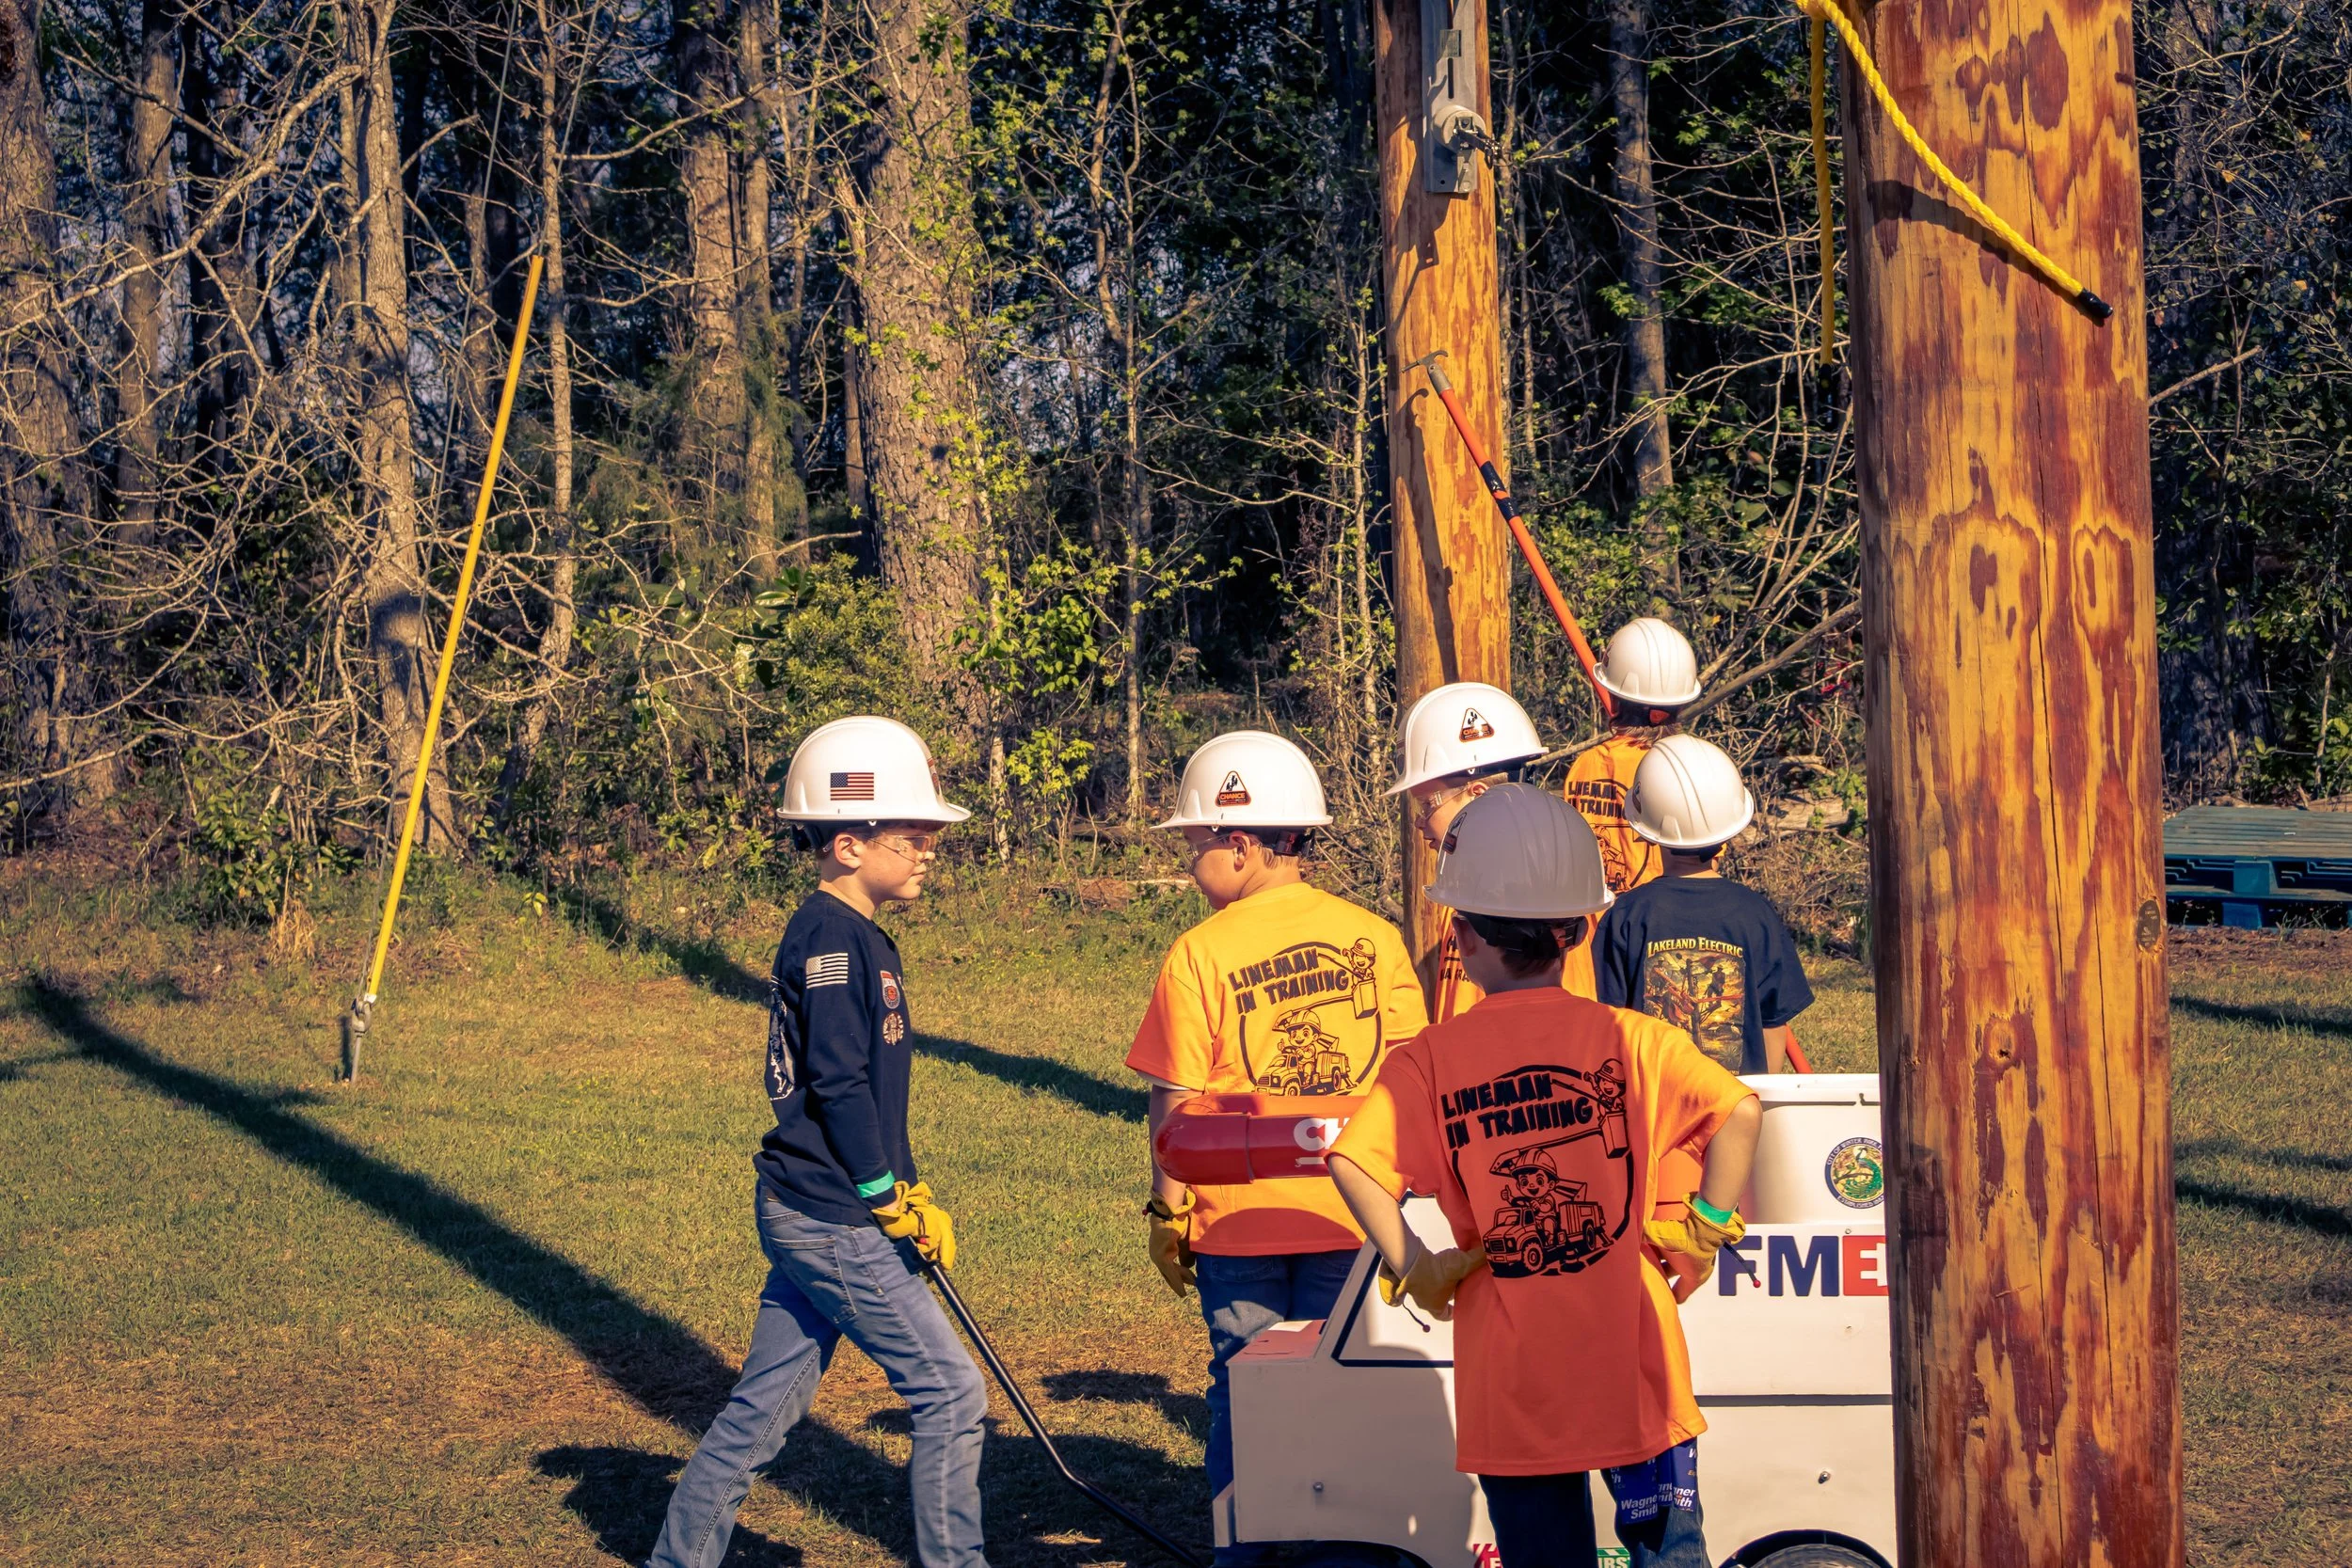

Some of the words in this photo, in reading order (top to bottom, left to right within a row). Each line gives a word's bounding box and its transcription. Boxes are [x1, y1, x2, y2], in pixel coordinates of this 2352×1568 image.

[1228, 947, 1320, 991] LINEMAN
[1647, 939, 1696, 958] LAKELAND
[1697, 936, 1743, 958] ELECTRIC
[1234, 989, 1258, 1014] IN
[1263, 968, 1349, 1006] TRAINING
[1440, 1072, 1554, 1119] LINEMAN
[1445, 1119, 1470, 1149] IN
[1477, 1096, 1594, 1140] TRAINING
[1621, 1494, 1657, 1511] Wagne
